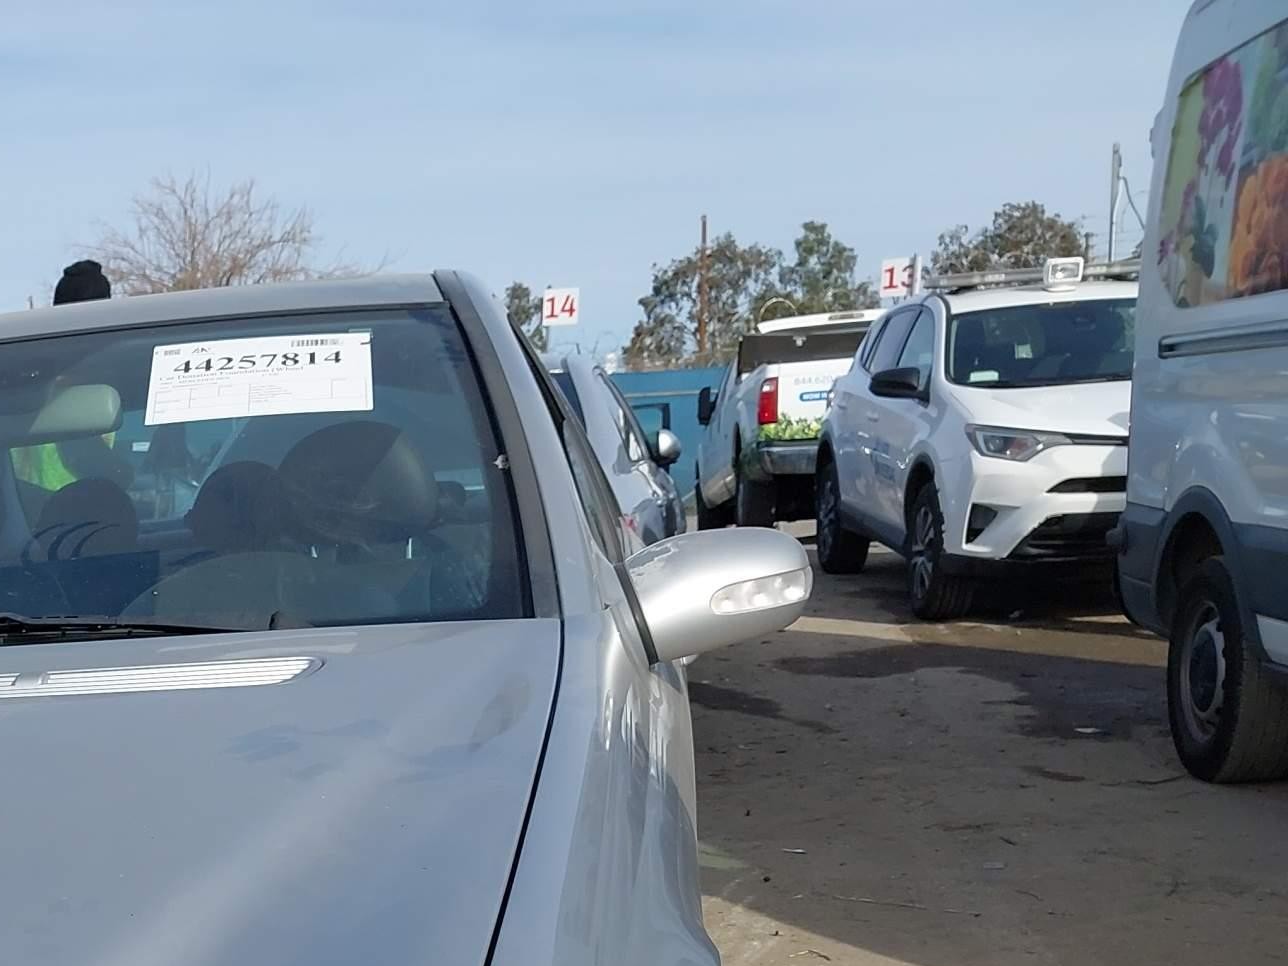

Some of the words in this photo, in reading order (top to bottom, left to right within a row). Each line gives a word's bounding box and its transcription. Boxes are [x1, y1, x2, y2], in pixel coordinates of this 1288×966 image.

[883, 264, 915, 289] 13
[545, 294, 576, 318] 14
[173, 350, 342, 373] 44257814
